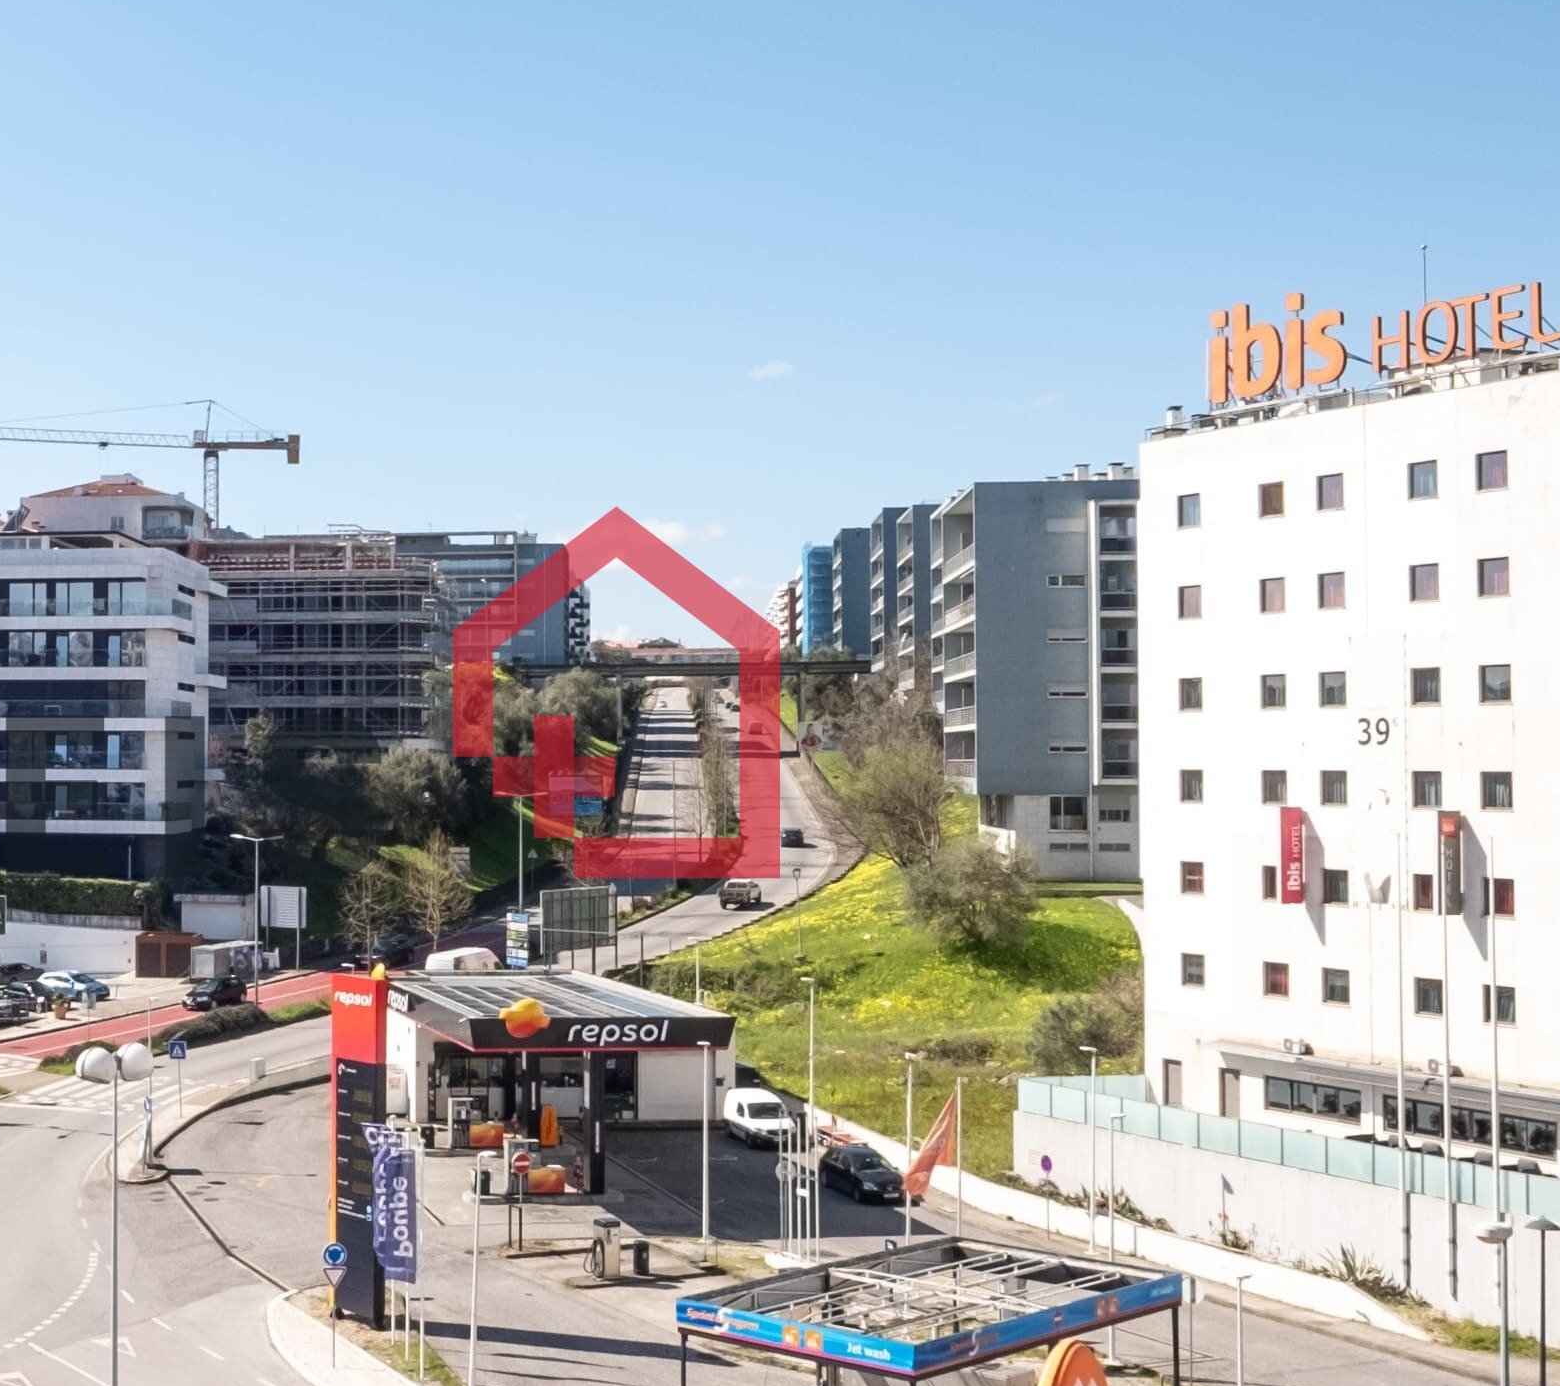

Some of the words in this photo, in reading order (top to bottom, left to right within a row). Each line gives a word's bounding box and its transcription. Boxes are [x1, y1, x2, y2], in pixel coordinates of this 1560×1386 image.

[1207, 292, 1347, 405] ibis
[334, 989, 373, 1008] repsol
[387, 989, 409, 1013] repsol
[566, 1018, 670, 1047] repsol
[847, 1342, 863, 1356] Jet
[864, 1345, 891, 1361] wash
